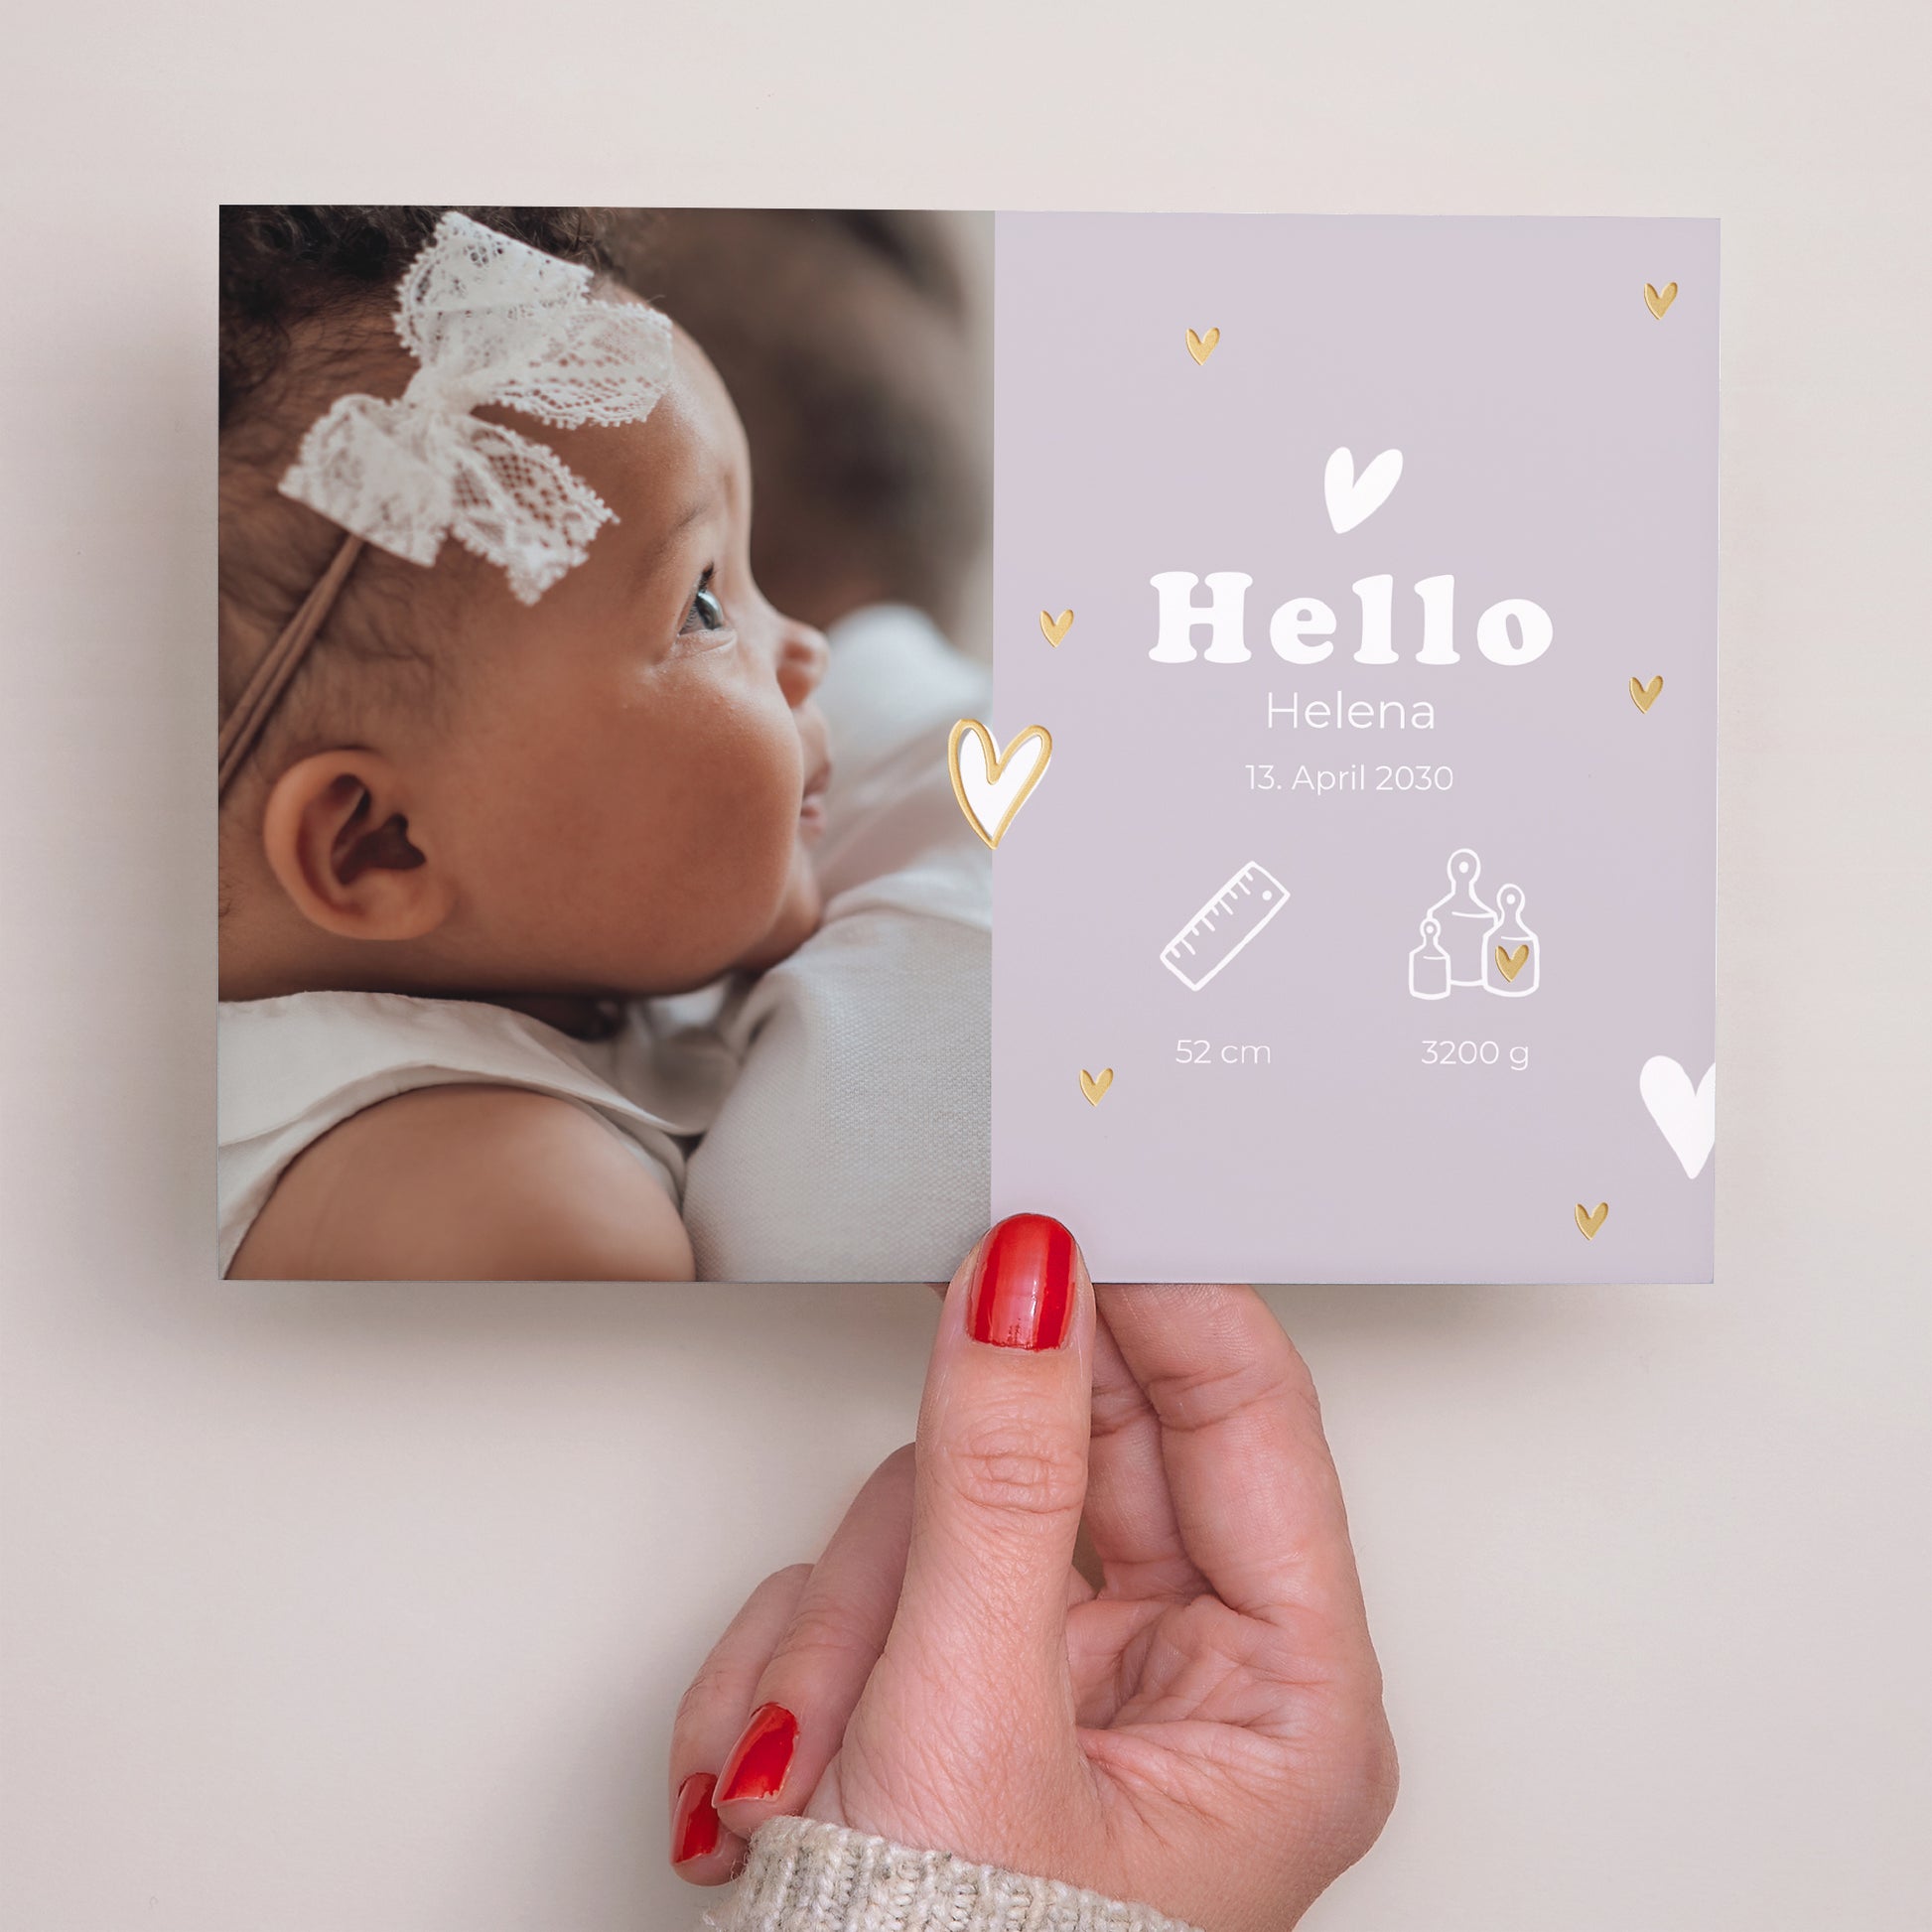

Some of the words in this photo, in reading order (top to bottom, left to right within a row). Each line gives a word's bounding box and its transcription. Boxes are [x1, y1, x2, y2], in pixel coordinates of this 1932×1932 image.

[1149, 571, 1554, 666] Hello
[1267, 691, 1436, 730] Helena
[1245, 764, 1283, 790] 13.
[1291, 764, 1365, 795] April
[1375, 765, 1453, 791] 2030
[1174, 1039, 1212, 1064] 52
[1220, 1044, 1272, 1064] cm
[1421, 1040, 1500, 1065] 3200
[1509, 1045, 1529, 1071] g
